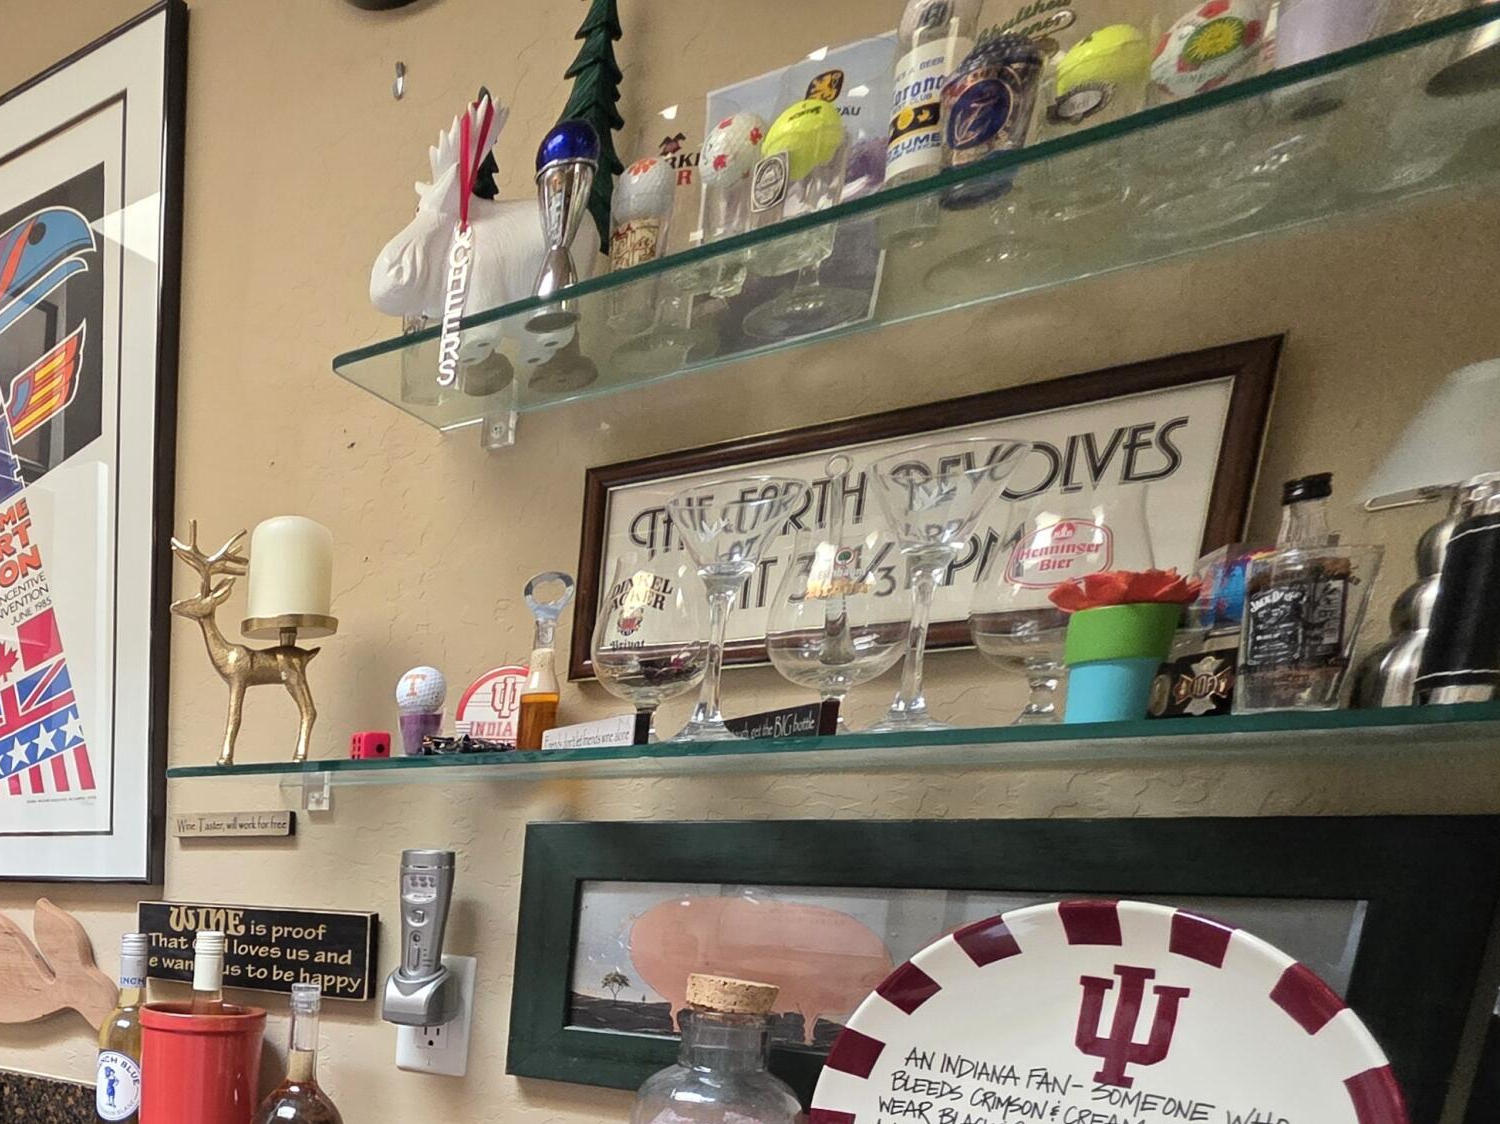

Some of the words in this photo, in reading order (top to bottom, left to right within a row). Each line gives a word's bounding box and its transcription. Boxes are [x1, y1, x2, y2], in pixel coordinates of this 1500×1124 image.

[436, 243, 472, 387] CHEERS
[1038, 558, 1075, 572] Bier
[405, 673, 428, 697] T
[469, 721, 513, 737] INDIA
[773, 713, 793, 738] BIG
[793, 710, 815, 733] bottle
[270, 815, 288, 829] free
[169, 905, 246, 936] WINE
[250, 920, 267, 935] is
[272, 923, 327, 943] proof
[148, 932, 189, 950] That
[233, 939, 281, 959] loves
[286, 947, 310, 961] us
[314, 949, 352, 965] and
[246, 962, 268, 978] to
[272, 964, 294, 982] be
[299, 967, 362, 993] happy
[891, 1070, 964, 1101] BLEEDS
[969, 1087, 1048, 1121] CRIMSON
[904, 1047, 936, 1070] AN
[940, 1053, 1021, 1087] INDIANA
[1091, 1084, 1216, 1122] SOMEONE
